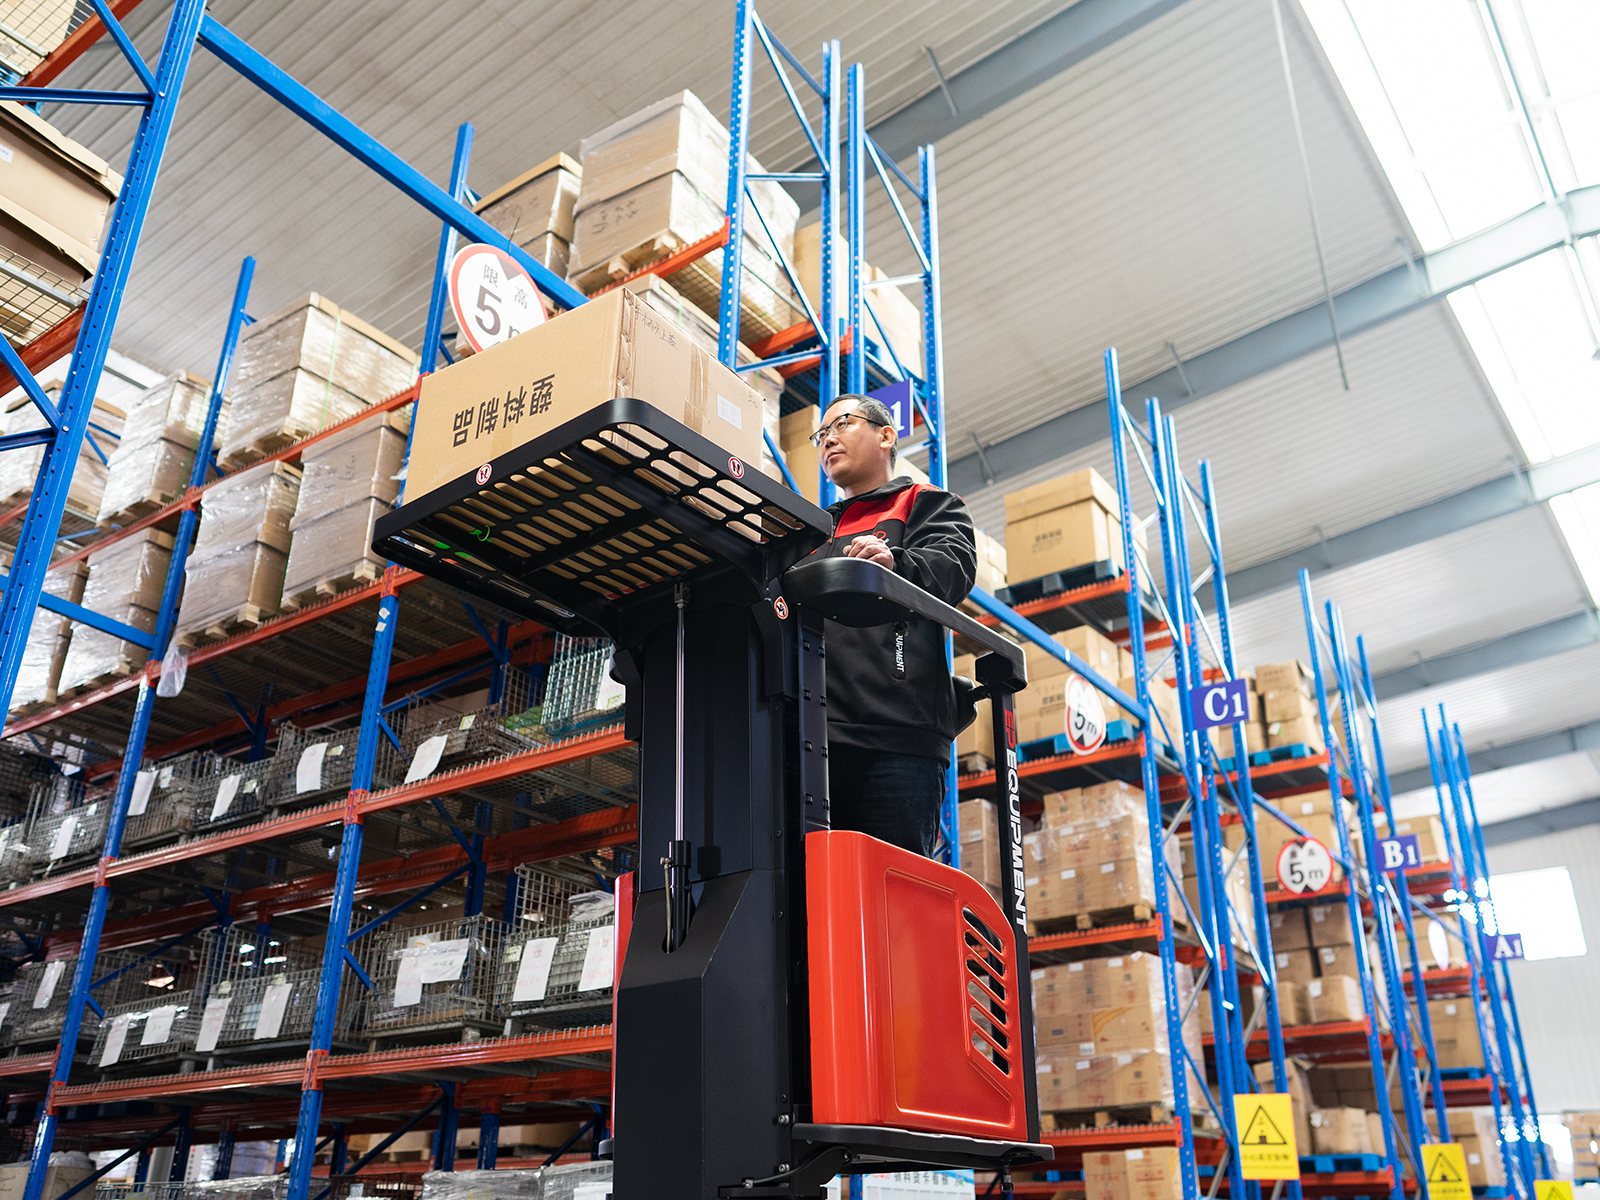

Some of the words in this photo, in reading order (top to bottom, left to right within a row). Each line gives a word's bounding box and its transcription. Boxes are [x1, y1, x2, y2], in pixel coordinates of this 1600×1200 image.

[452, 373, 556, 448] 塑料制品
[890, 400, 905, 432] 1
[1203, 686, 1246, 722] C1
[1381, 840, 1418, 869] B1
[1494, 936, 1524, 959] A1
